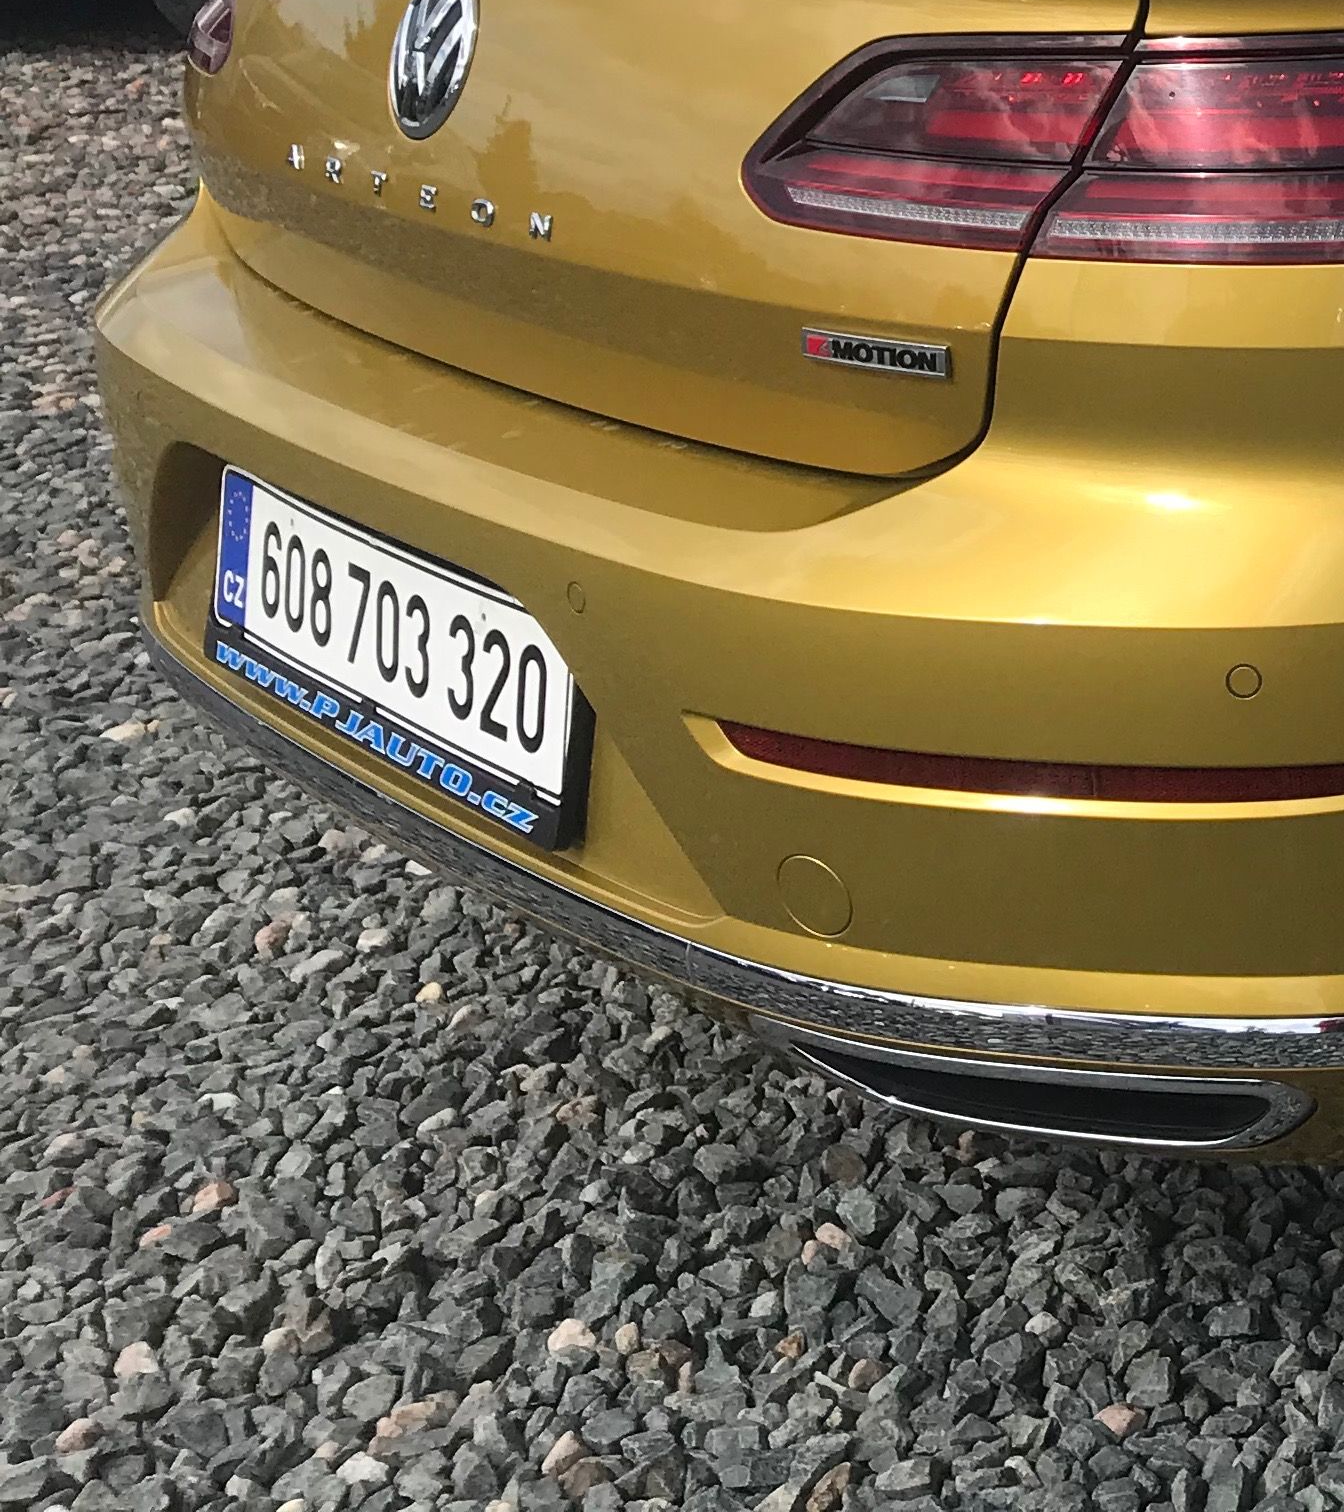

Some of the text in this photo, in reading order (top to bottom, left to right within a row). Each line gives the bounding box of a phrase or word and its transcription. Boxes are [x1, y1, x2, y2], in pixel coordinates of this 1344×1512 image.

[223, 569, 244, 608] CZ
[261, 521, 548, 754] 608 703 320
